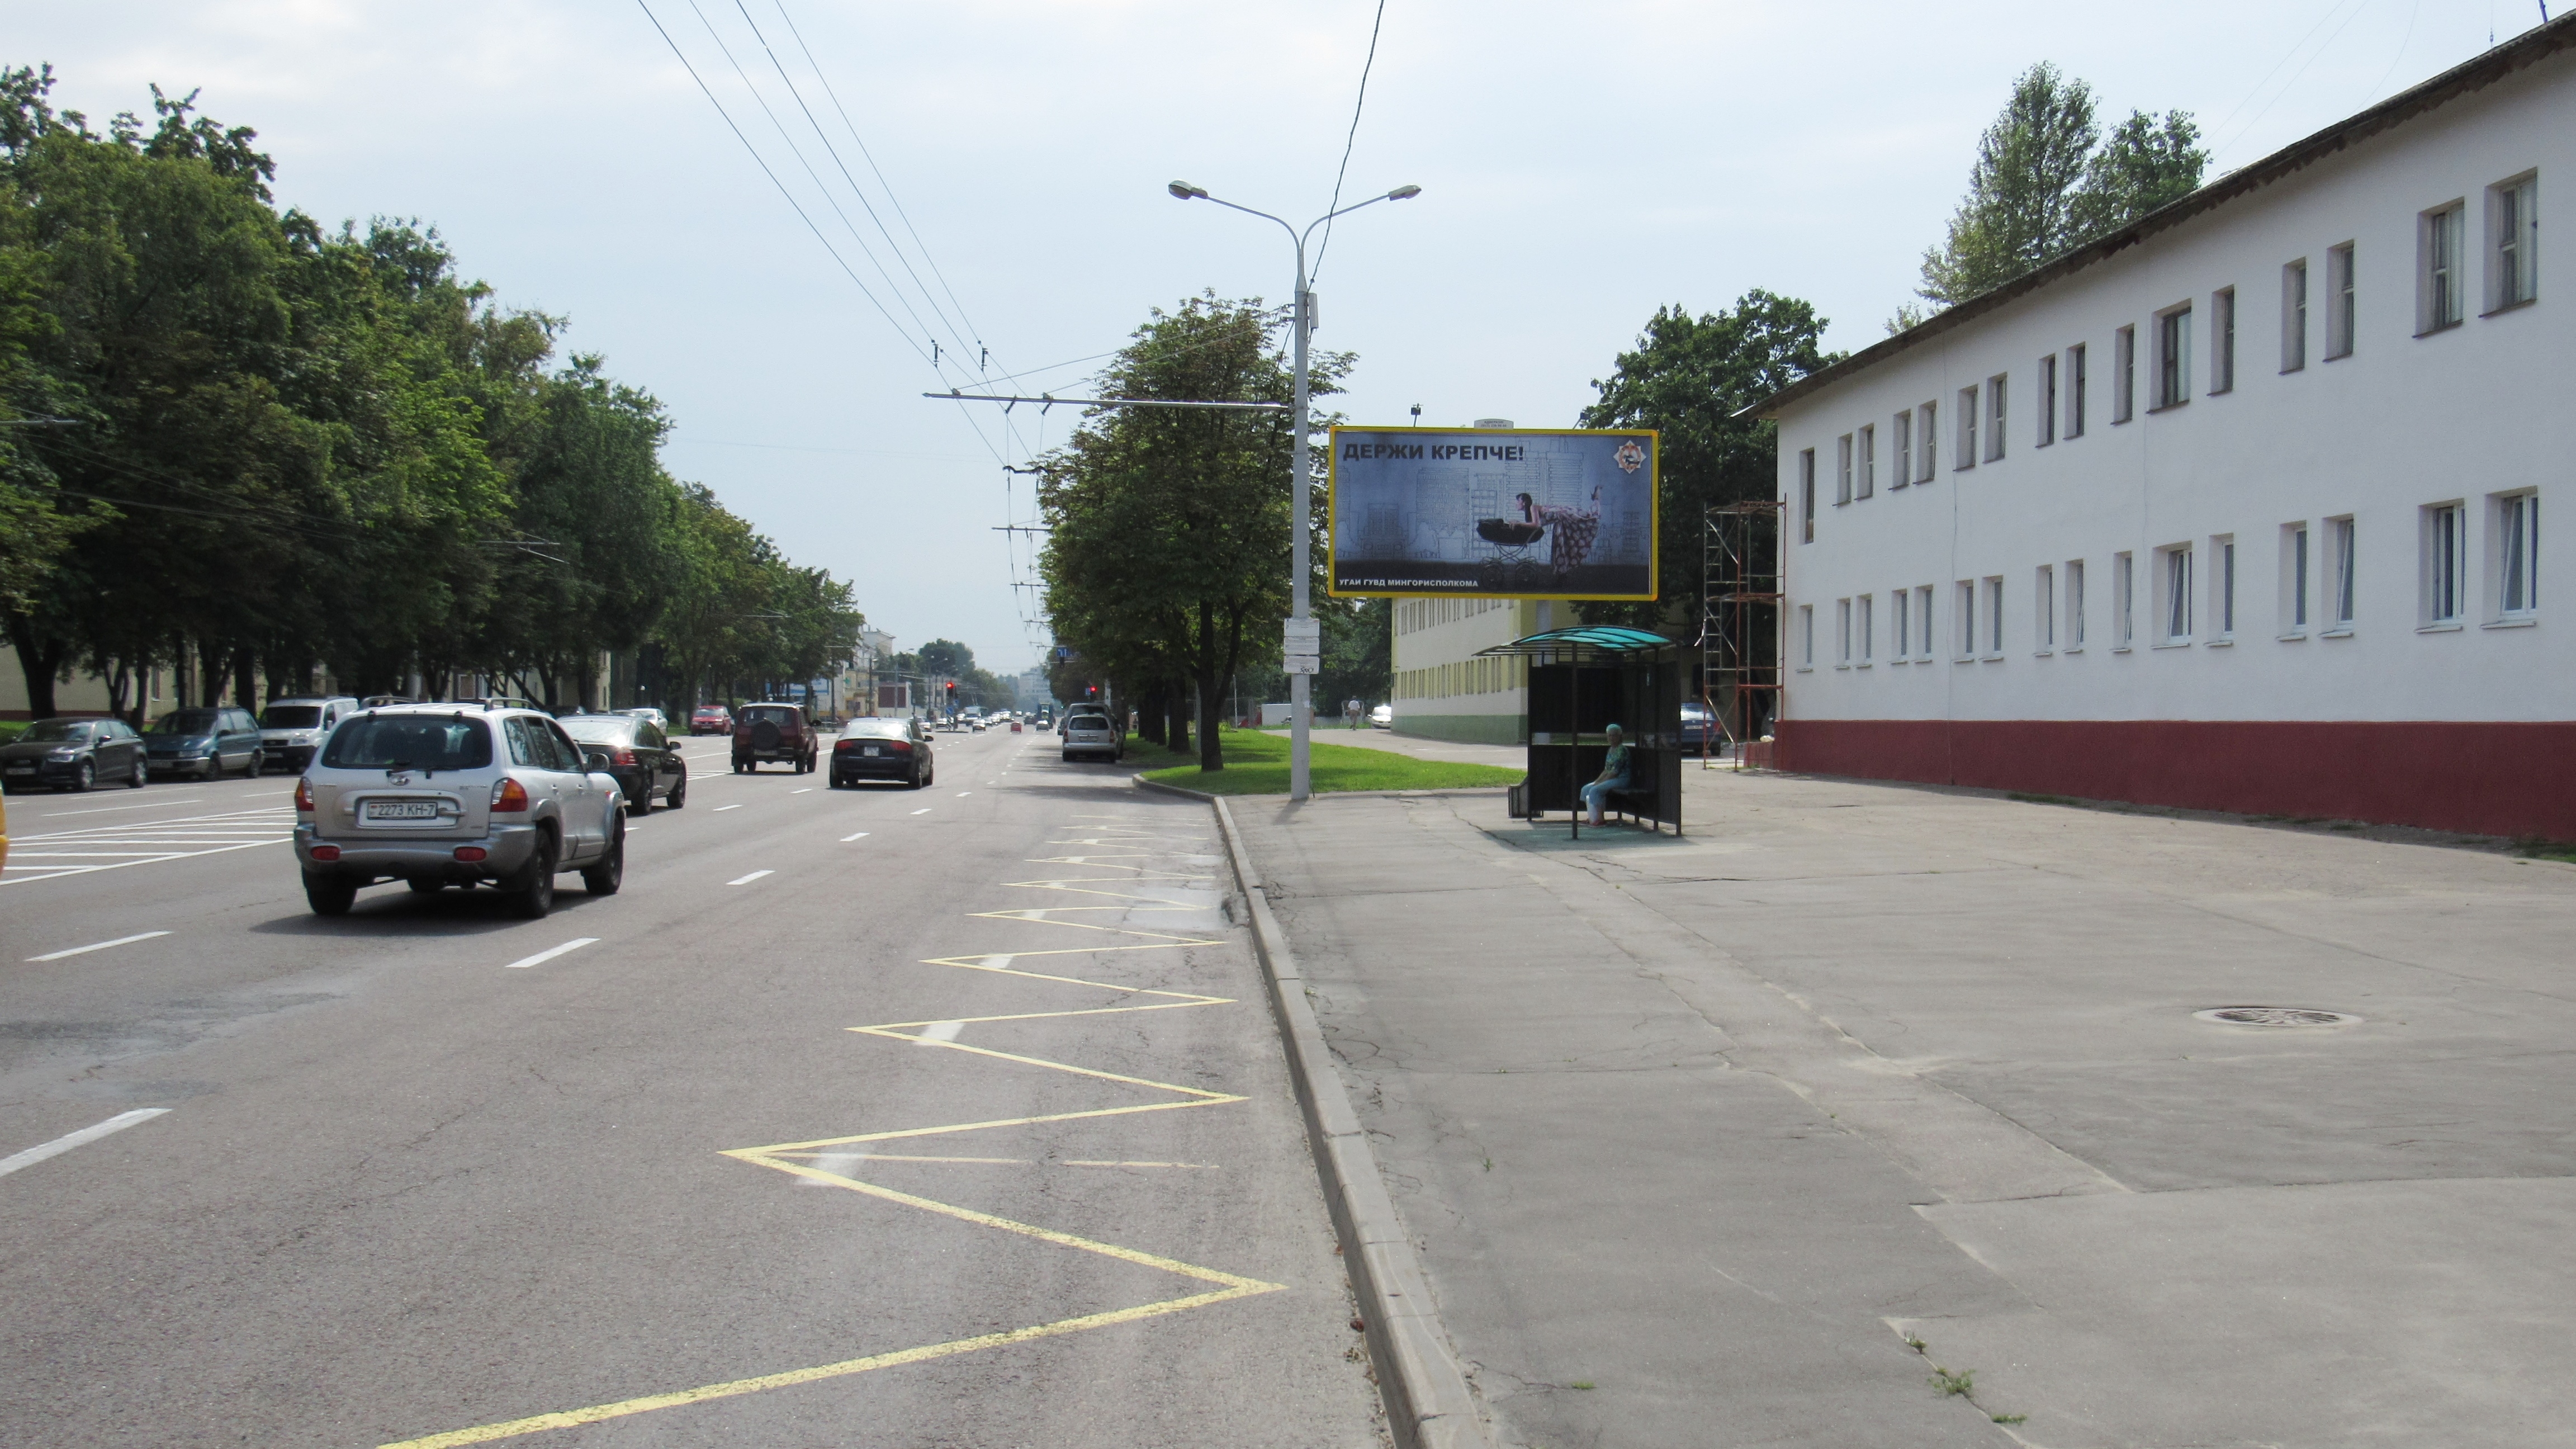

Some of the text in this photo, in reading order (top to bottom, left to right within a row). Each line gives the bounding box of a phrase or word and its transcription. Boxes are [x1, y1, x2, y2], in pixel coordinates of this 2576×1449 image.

[1343, 444, 1523, 461] ДЕРЖИ КРЕПЧЕ!
[379, 805, 403, 815] 2273
